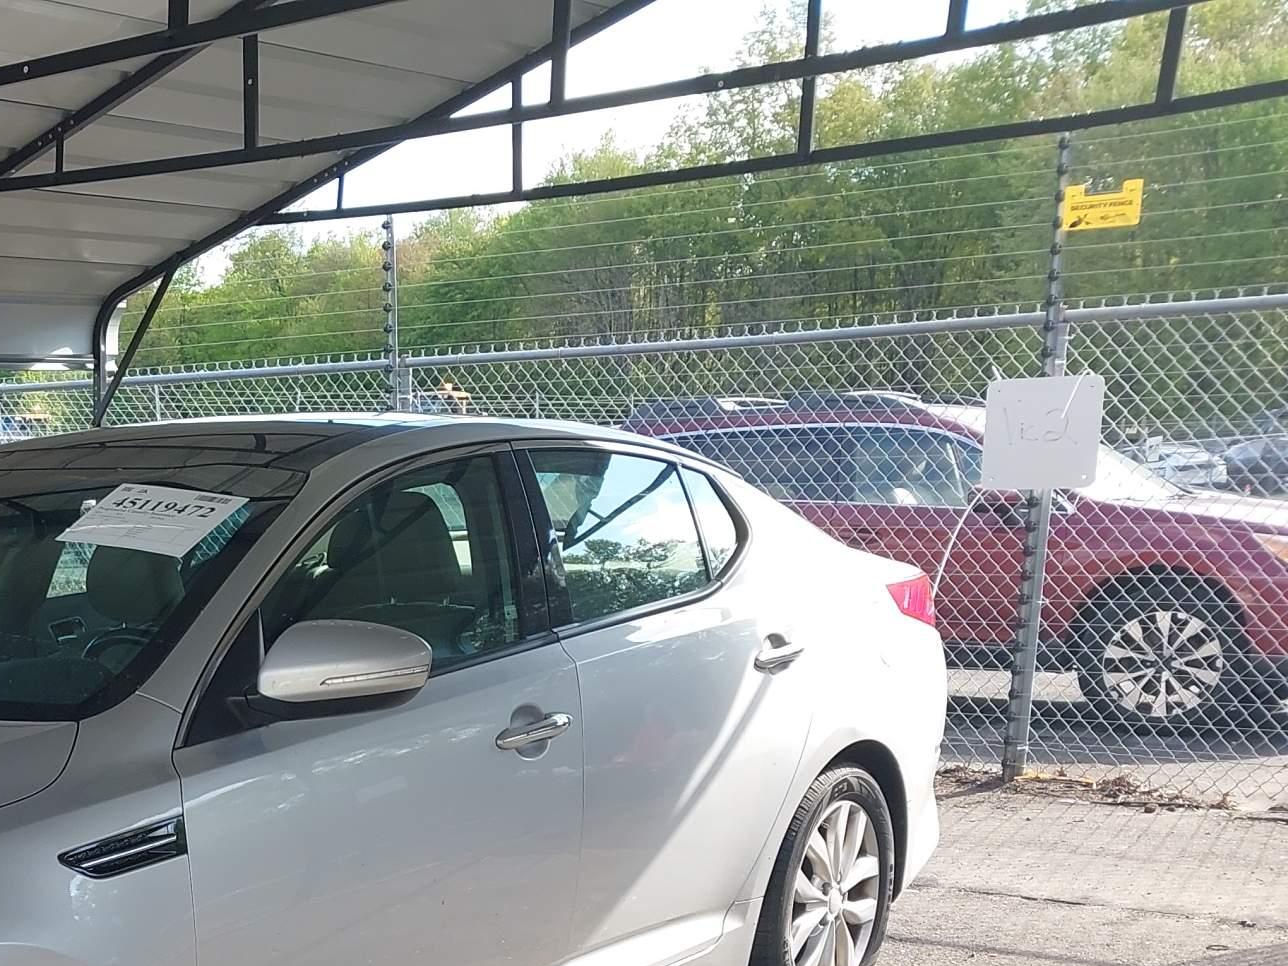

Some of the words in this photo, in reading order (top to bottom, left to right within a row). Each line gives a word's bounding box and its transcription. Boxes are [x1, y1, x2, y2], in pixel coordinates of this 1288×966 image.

[1070, 202, 1108, 211] SECURITY
[1109, 199, 1133, 207] FENCE
[112, 496, 216, 518] 45119472
